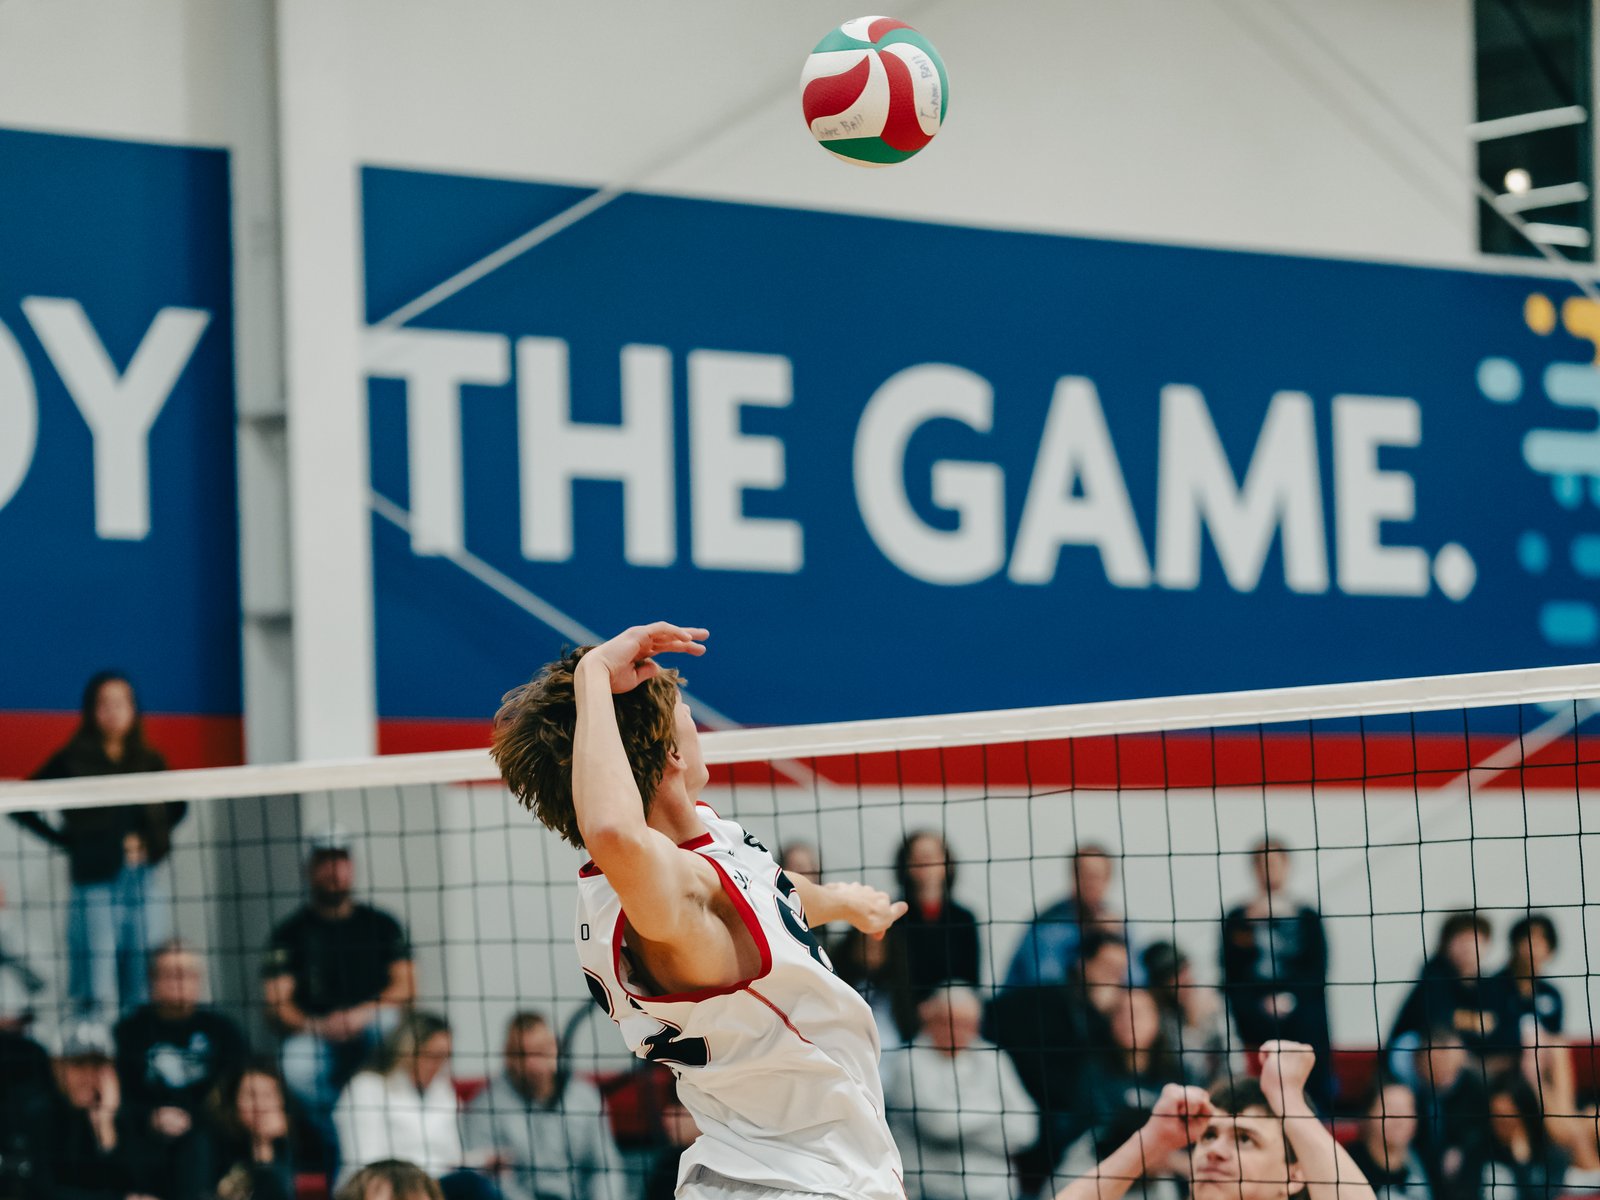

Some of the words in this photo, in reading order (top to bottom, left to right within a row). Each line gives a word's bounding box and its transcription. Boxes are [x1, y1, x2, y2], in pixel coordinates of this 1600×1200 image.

[0, 294, 212, 541] Y
[363, 325, 803, 573] THE
[852, 361, 1478, 602] GAME.
